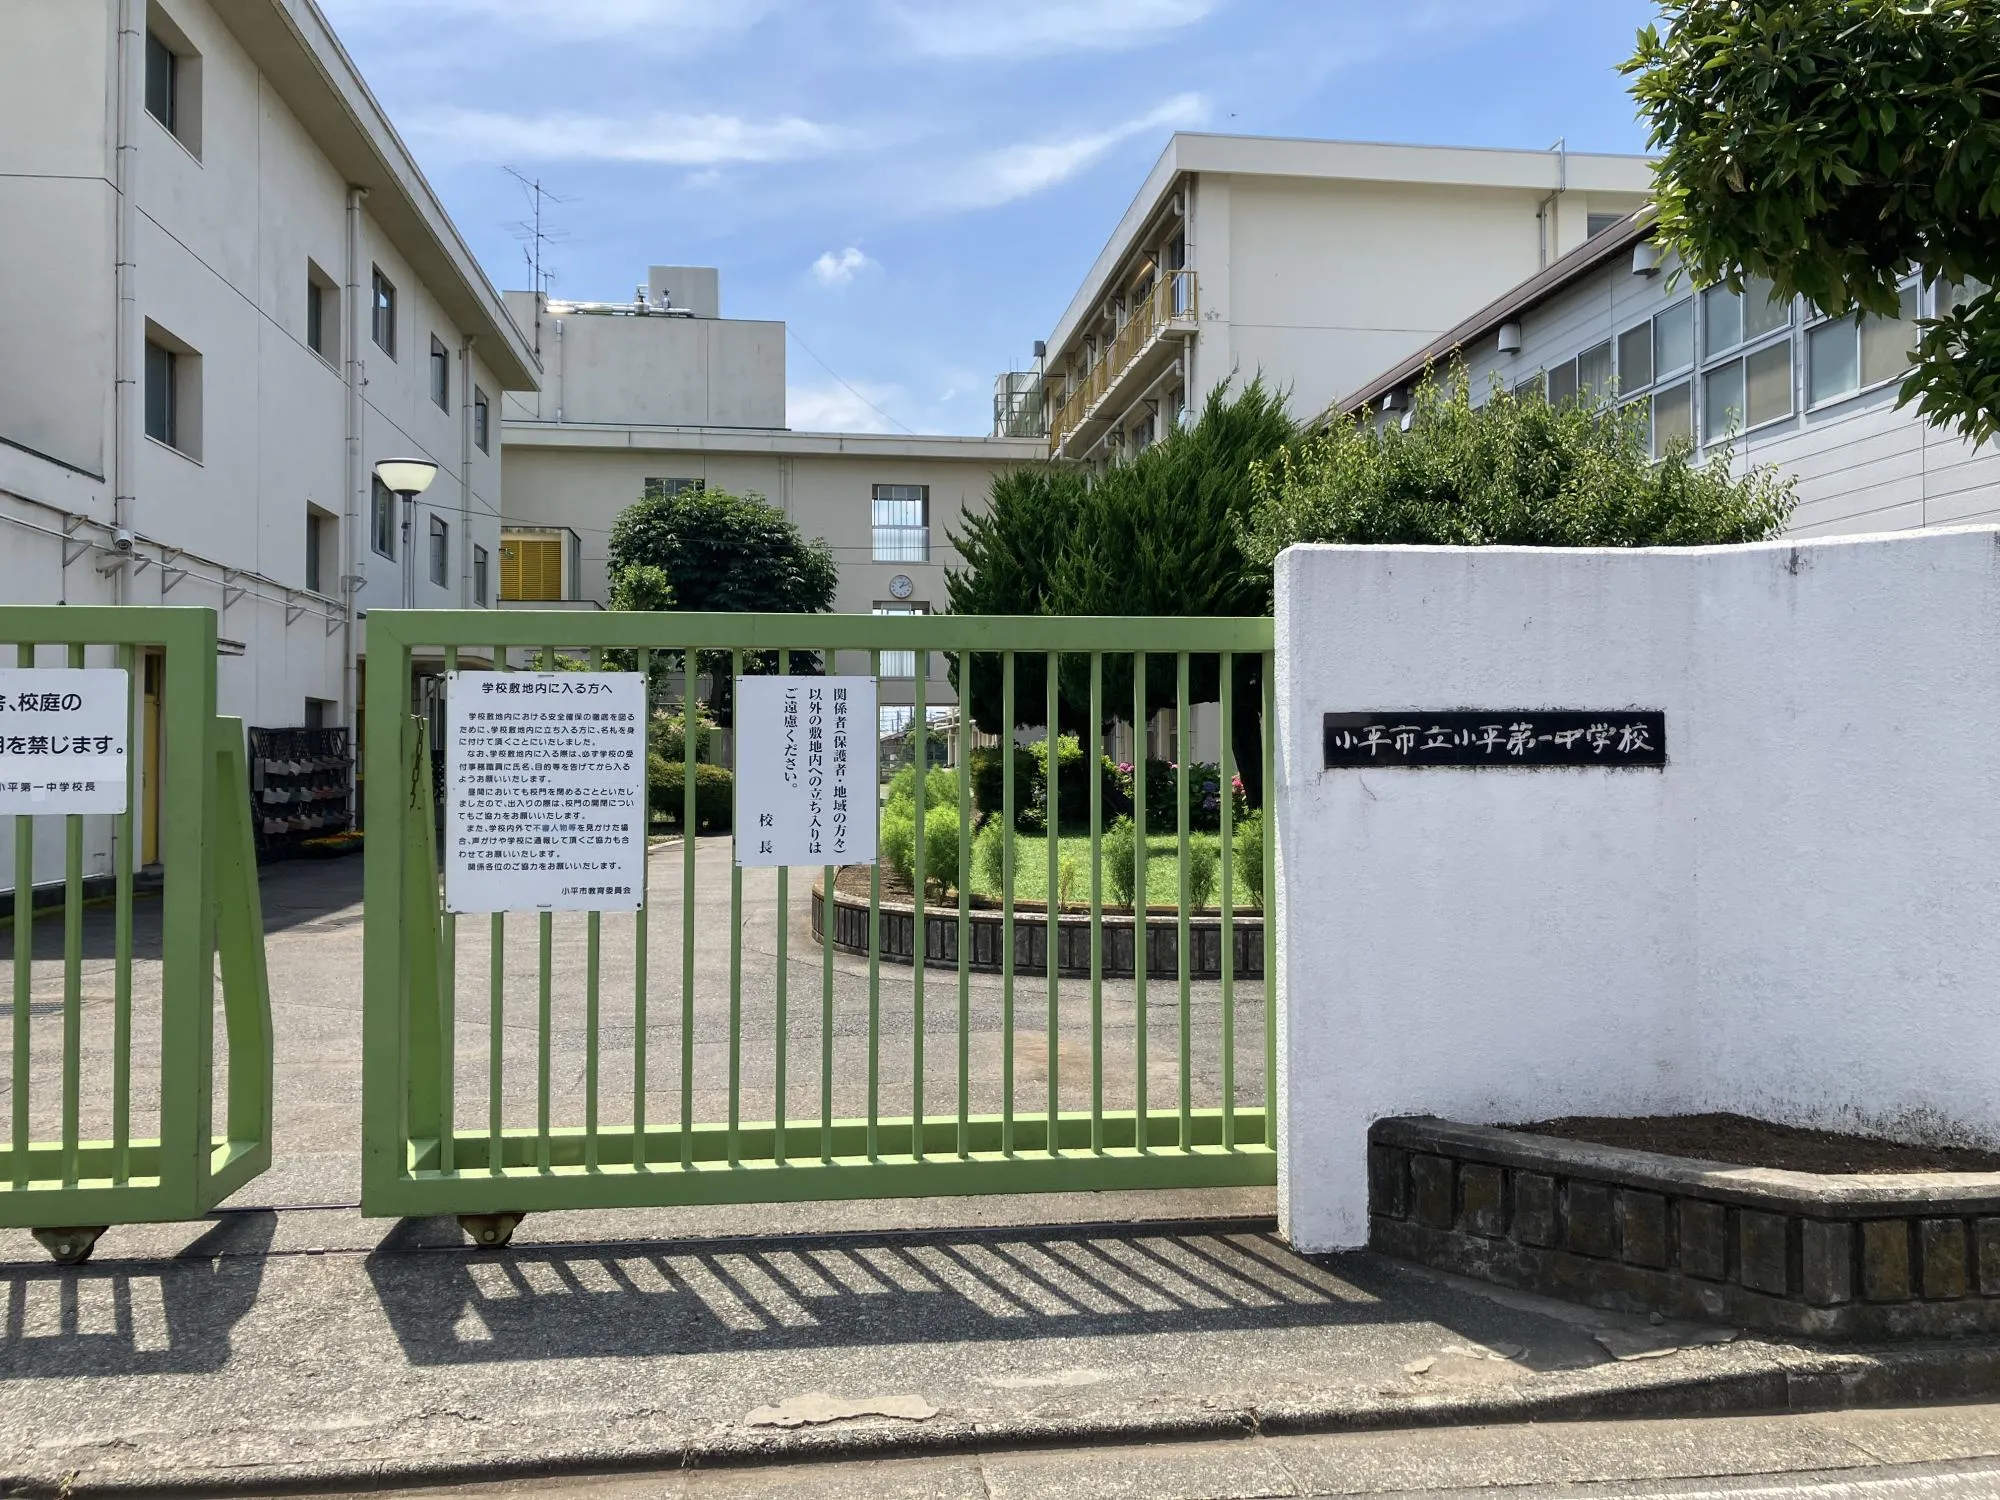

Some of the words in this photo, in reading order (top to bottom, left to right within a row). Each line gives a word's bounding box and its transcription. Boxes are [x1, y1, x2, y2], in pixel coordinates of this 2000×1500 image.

[481, 682, 613, 694] 学校敷地内に入る方へ
[468, 713, 635, 721] 学校敷地内における安全確保の徹底を図る
[459, 726, 635, 735] ために、学校敷地内に立ち入る方に、名札を身
[458, 738, 596, 746] に付けて頂くことにいたしました。
[784, 687, 798, 789] ご遠慮ください。
[1336, 721, 1655, 756] 小平市立小平第一中学校
[0, 736, 124, 754] を禁じます。
[467, 750, 634, 758] なお、学校敷地内に入る際は、必ず学校の受
[459, 762, 630, 771] 付事務職員に氏名、目的等を告げてから入る
[808, 688, 823, 854] 以外の敷地内への立ち入りは
[458, 775, 552, 783] ようお願いいたします。
[467, 788, 634, 797] 昼間においても校門を閉めることといたし
[459, 799, 635, 808] ましたので、出入りの際は、校門の開閉につい
[458, 811, 586, 820] てもご協力をお願いいたします。
[466, 823, 629, 833] また、学校内外で不審人物等を見かけた場
[458, 836, 630, 845] 合、声がけや学校に通報して頂くご協力も合
[458, 850, 561, 858] わせてお願いいたします。
[467, 862, 622, 871] 関係各位のご協力をお願いいたします。
[561, 886, 631, 895] 小平市教育委員会
